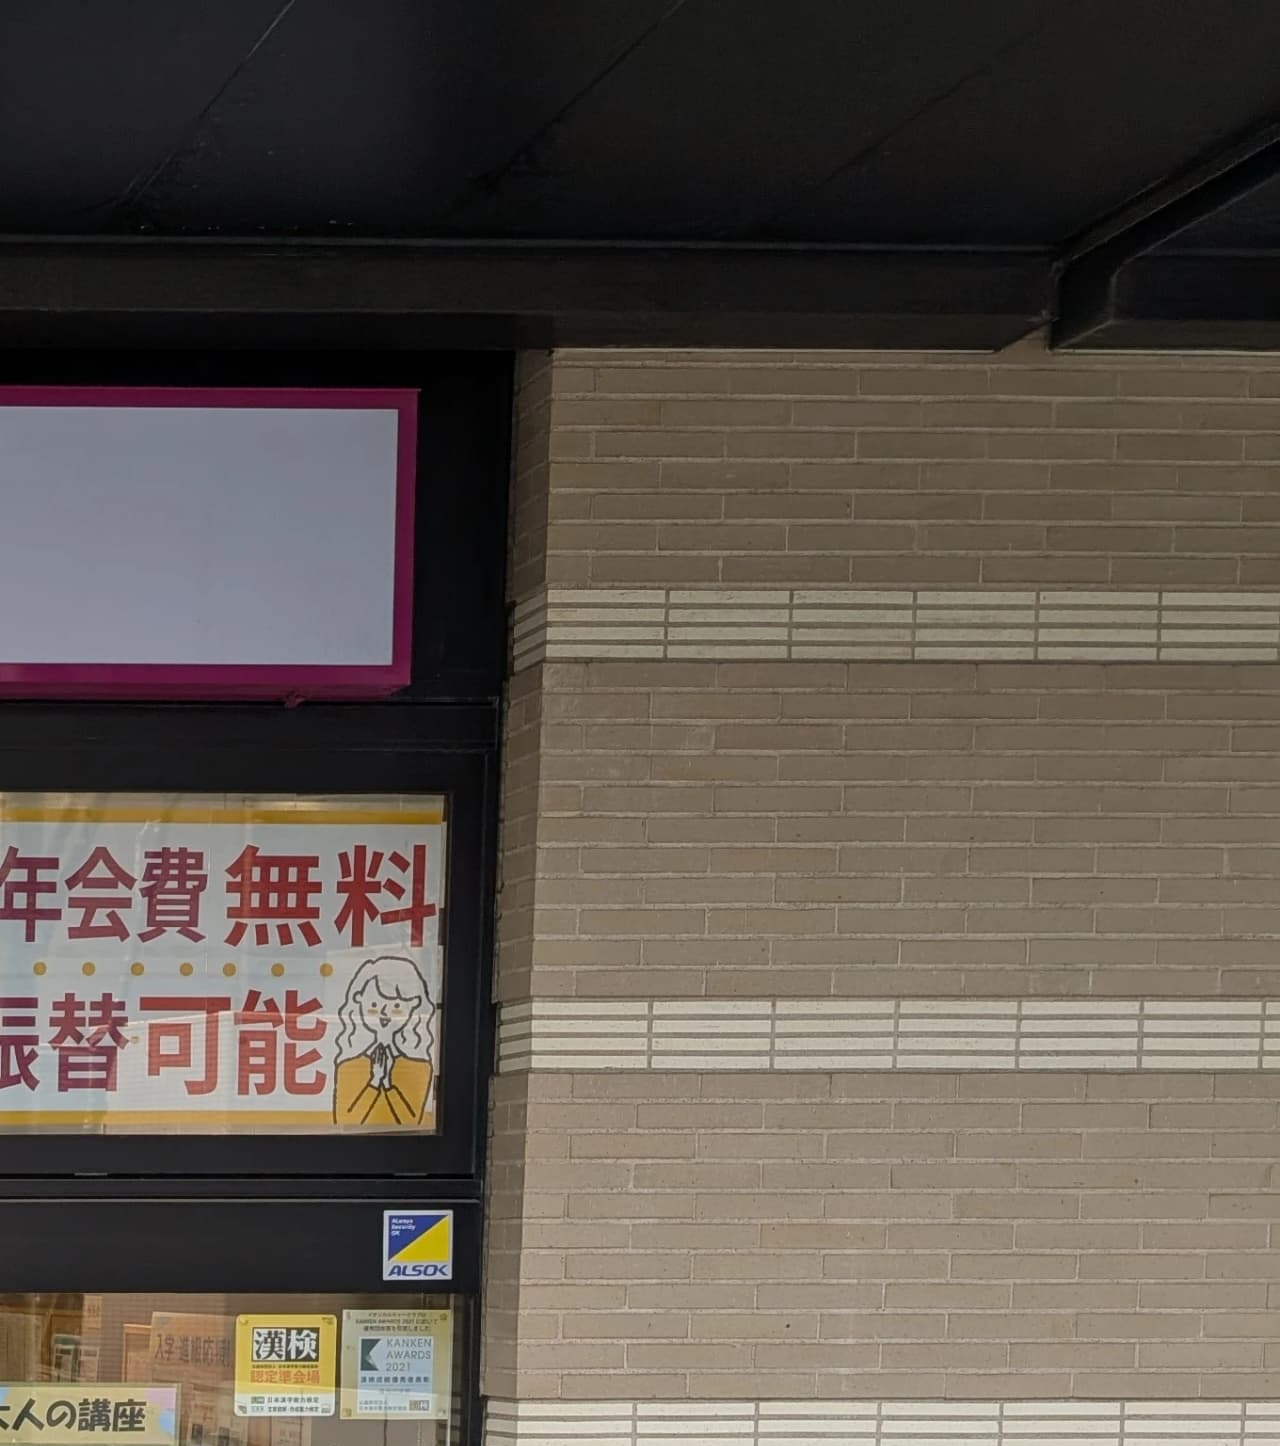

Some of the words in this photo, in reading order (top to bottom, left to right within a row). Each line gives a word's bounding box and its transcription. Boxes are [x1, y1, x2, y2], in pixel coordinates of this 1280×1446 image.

[388, 1264, 449, 1277] ALSOK
[253, 1328, 319, 1361] 漢検
[385, 1338, 432, 1348] KANKEN
[385, 1350, 432, 1360] AWARDS
[385, 1362, 411, 1371] 2021
[250, 1369, 320, 1384] 認定準会場
